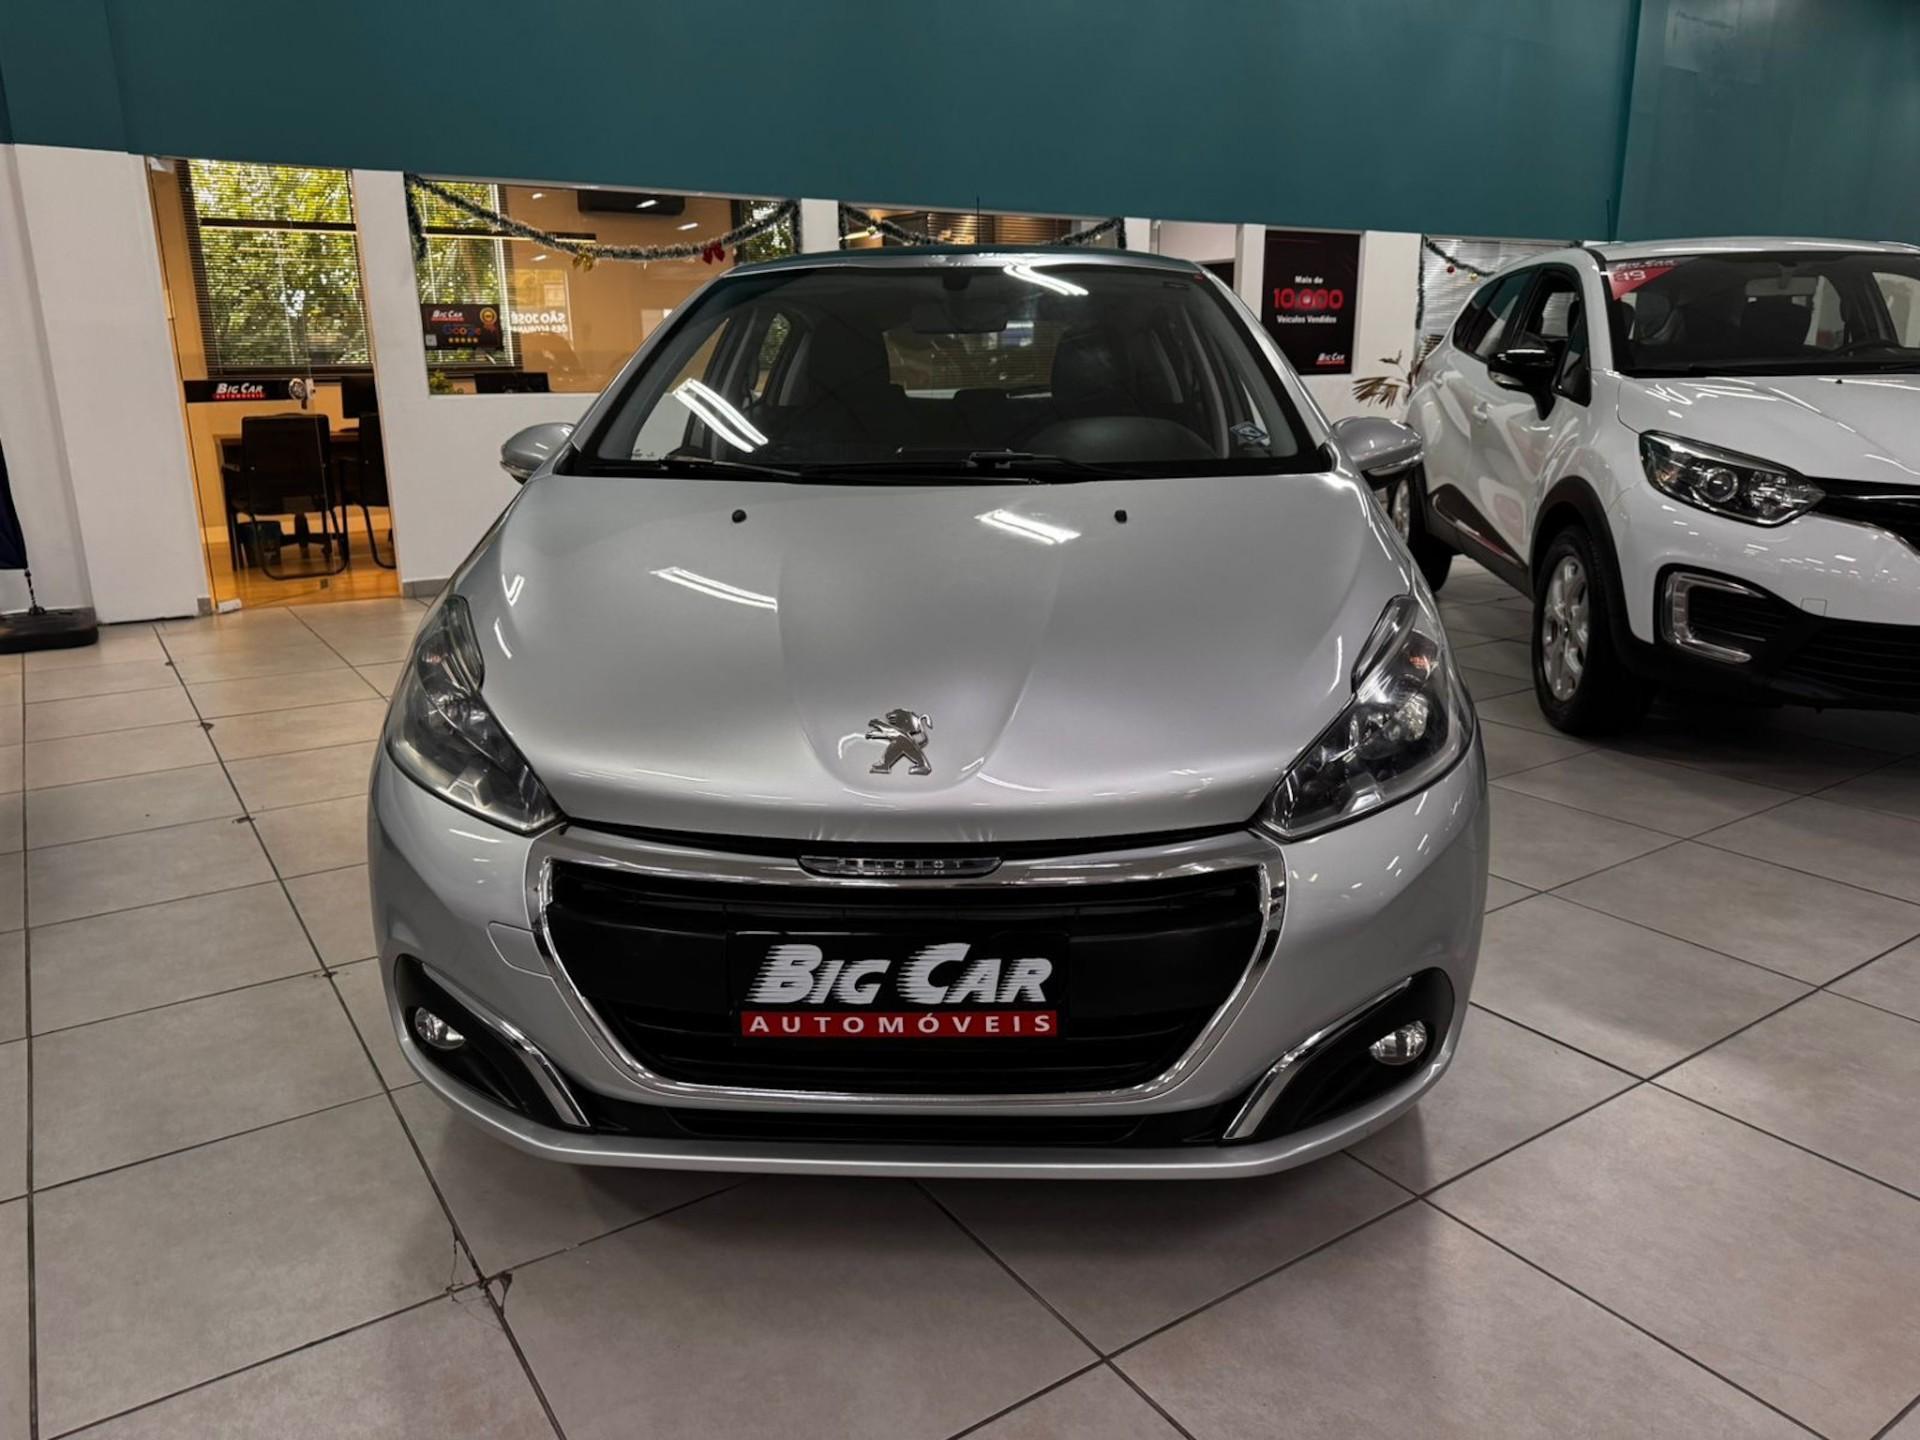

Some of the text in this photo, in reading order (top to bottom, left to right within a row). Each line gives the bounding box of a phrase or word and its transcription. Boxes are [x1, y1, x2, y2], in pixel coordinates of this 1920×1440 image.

[216, 382, 264, 394] BIG CAR
[744, 942, 1053, 1004] BIG CAR
[749, 1013, 1051, 1034] AUTOMÓVEIS
